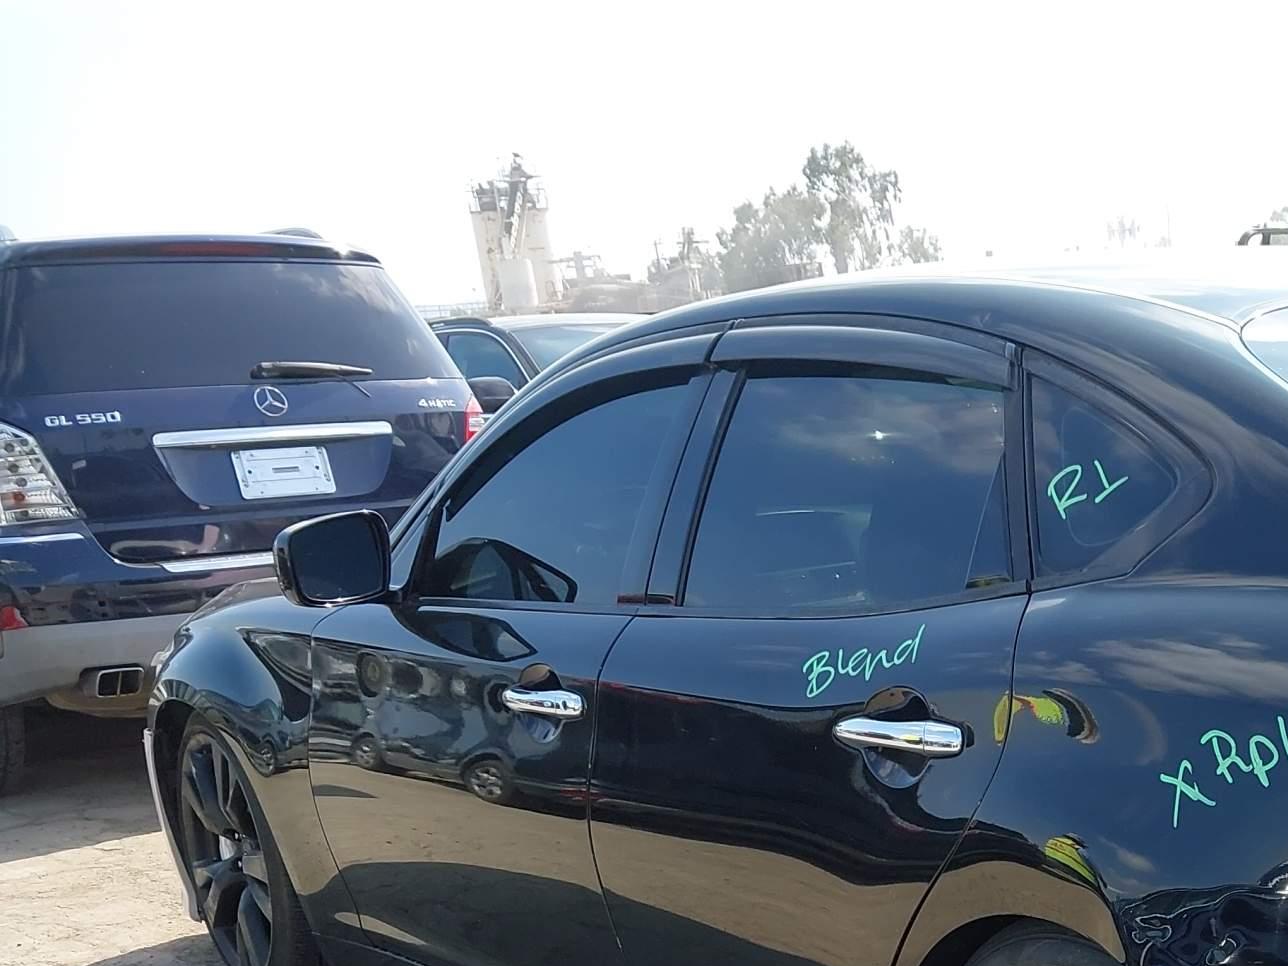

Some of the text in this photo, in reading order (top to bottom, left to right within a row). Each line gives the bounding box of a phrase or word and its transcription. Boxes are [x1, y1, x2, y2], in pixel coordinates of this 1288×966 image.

[44, 410, 121, 427] GL 550
[802, 624, 926, 699] Blend
